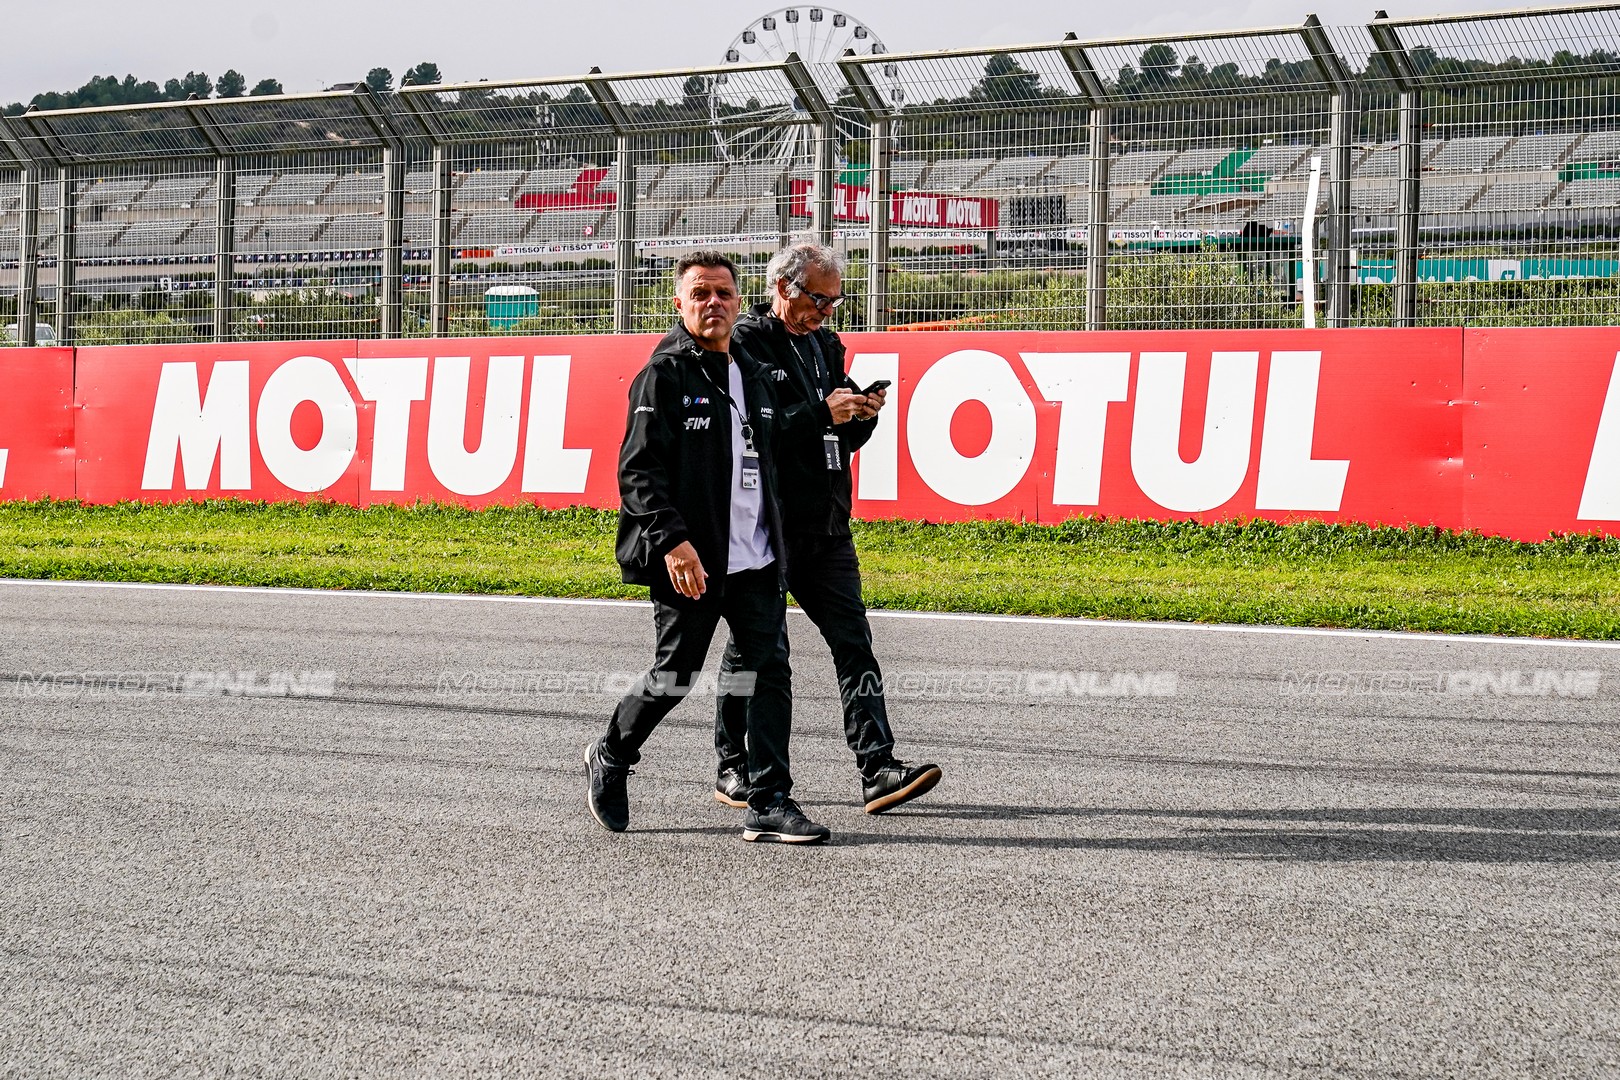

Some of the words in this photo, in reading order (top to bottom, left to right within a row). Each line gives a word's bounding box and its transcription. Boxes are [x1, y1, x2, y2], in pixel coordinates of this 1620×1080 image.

[805, 185, 847, 215] MUL
[902, 195, 939, 222] MOTUL
[946, 199, 982, 226] MOTUL
[960, 230, 987, 238] TSSOT
[1123, 231, 1150, 239] TISSOT
[1165, 231, 1194, 239] TISSOT
[513, 246, 546, 254] TISSOT
[562, 243, 593, 252] TISSOT
[141, 355, 593, 496] MOTUL
[683, 416, 711, 431] FIM
